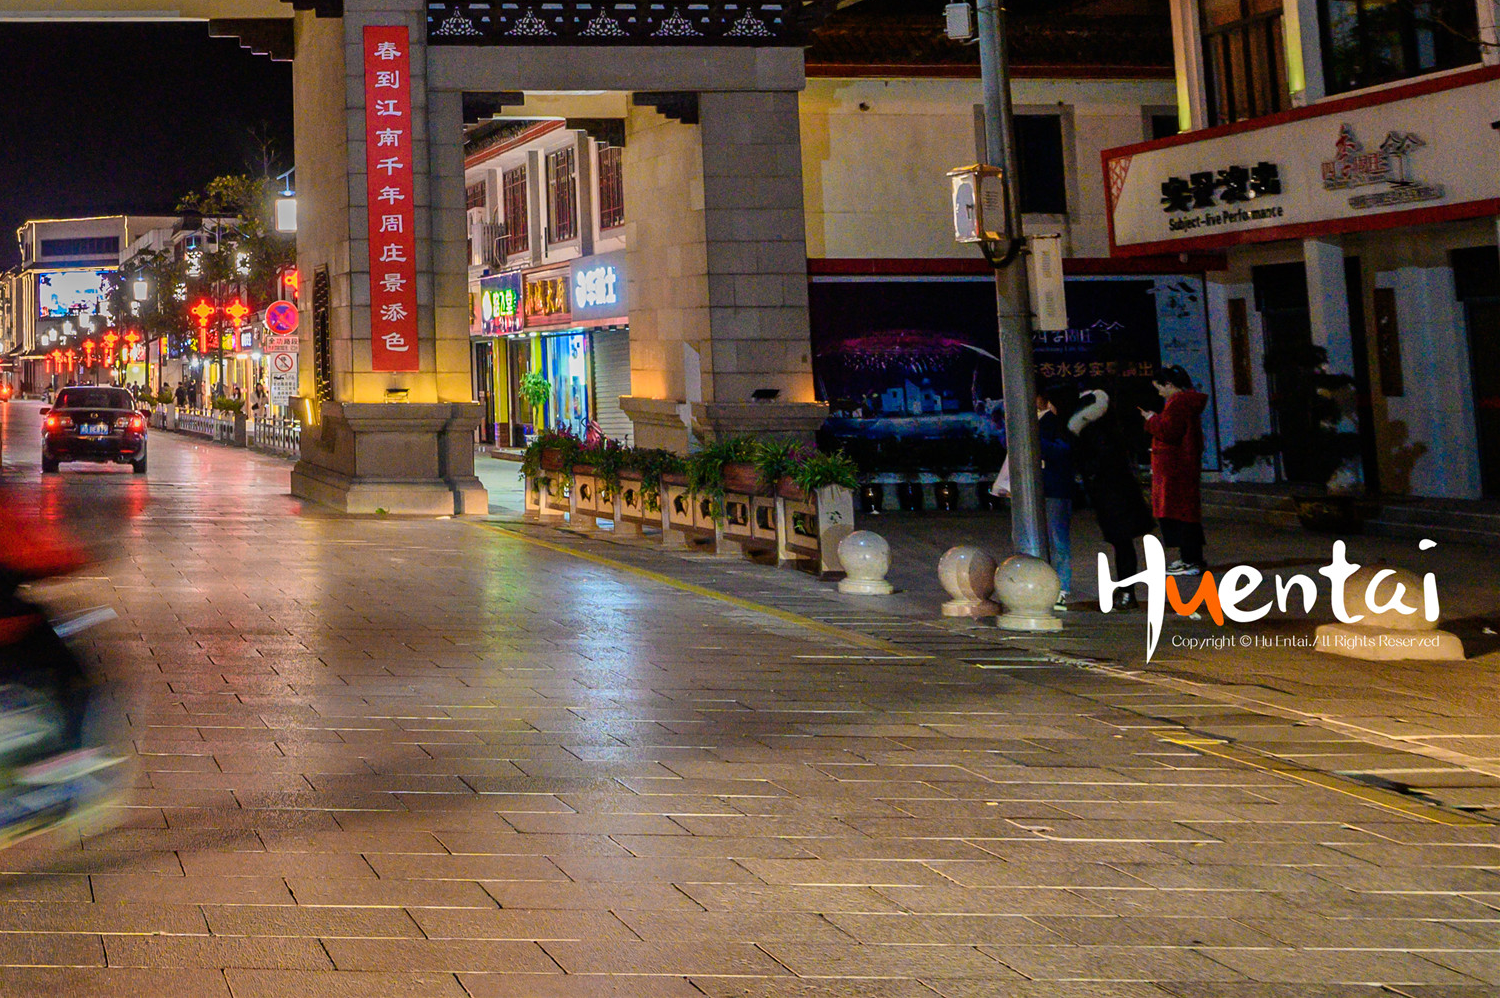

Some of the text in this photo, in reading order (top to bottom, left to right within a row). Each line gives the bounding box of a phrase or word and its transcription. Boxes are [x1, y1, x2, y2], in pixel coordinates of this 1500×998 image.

[373, 41, 410, 353] 春到江南千年周庄景添色
